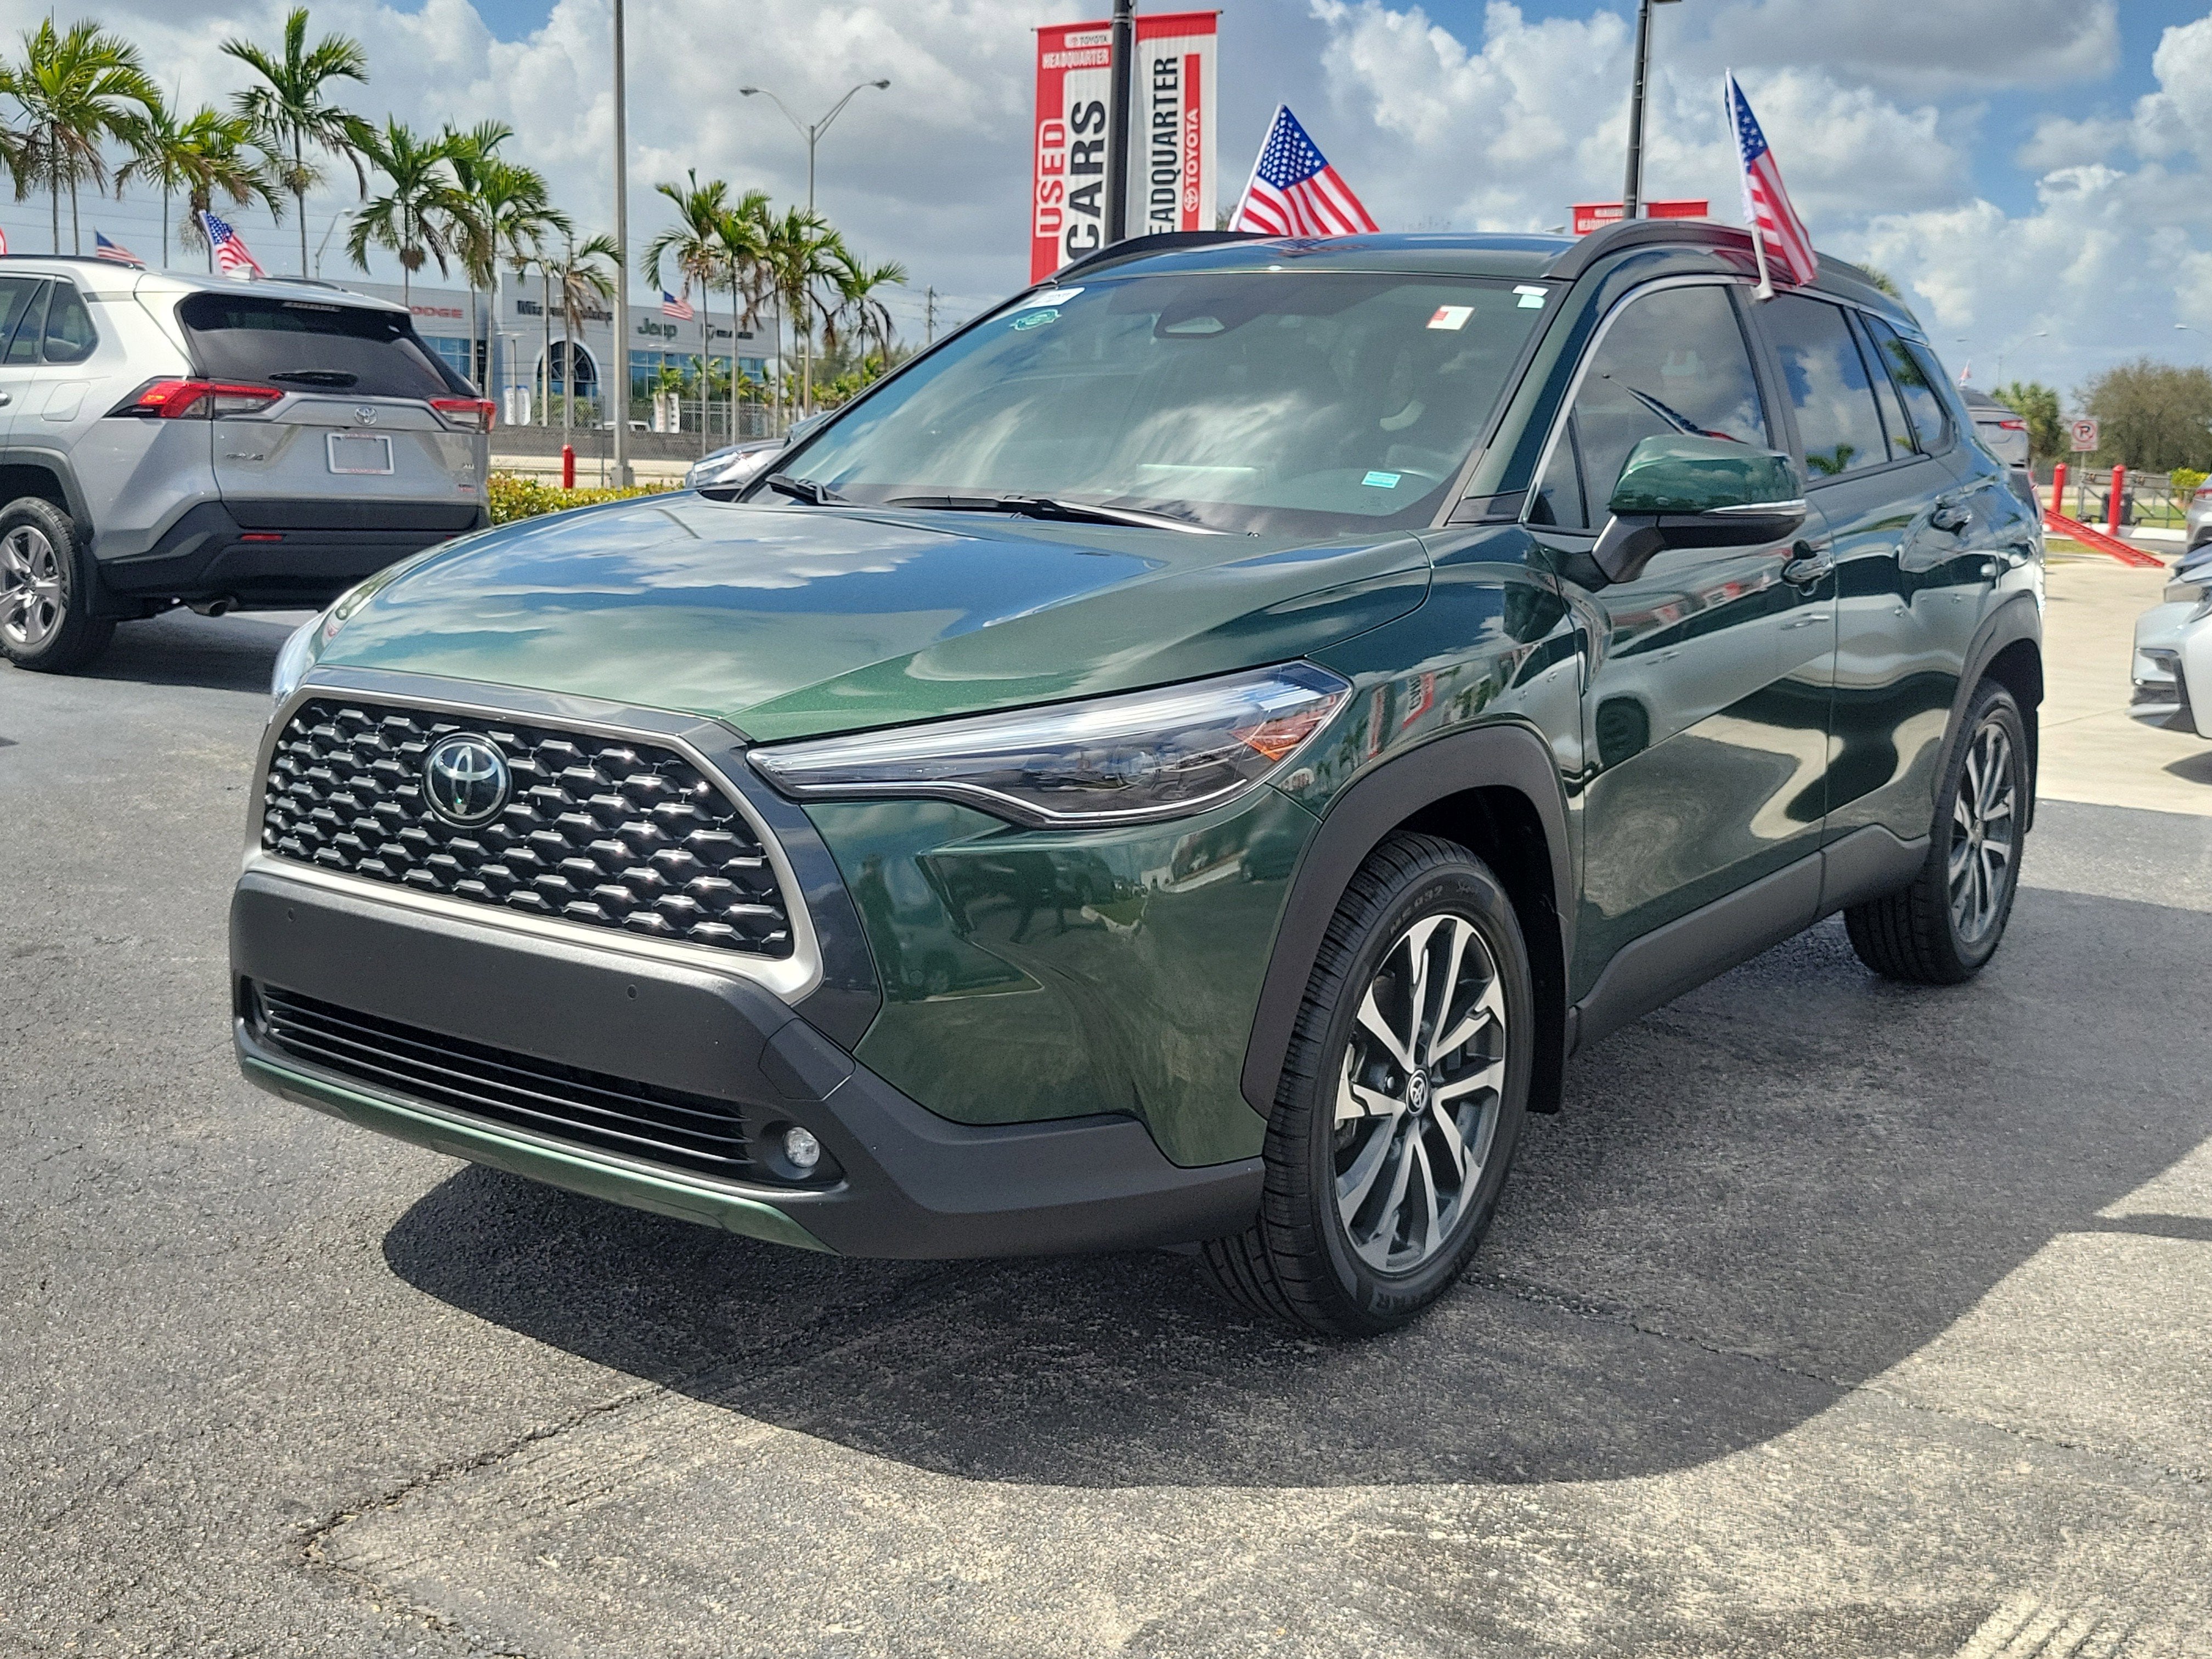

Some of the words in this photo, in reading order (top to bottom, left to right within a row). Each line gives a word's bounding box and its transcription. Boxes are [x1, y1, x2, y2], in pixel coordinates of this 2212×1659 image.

[1042, 47, 1109, 69] HEADQUARTER
[1079, 35, 1108, 45] TOYOTA
[1037, 120, 1065, 236] USED
[1066, 100, 1105, 261] CARS
[1149, 57, 1181, 235] EADQUARTER
[1185, 109, 1199, 187] TOYOTA
